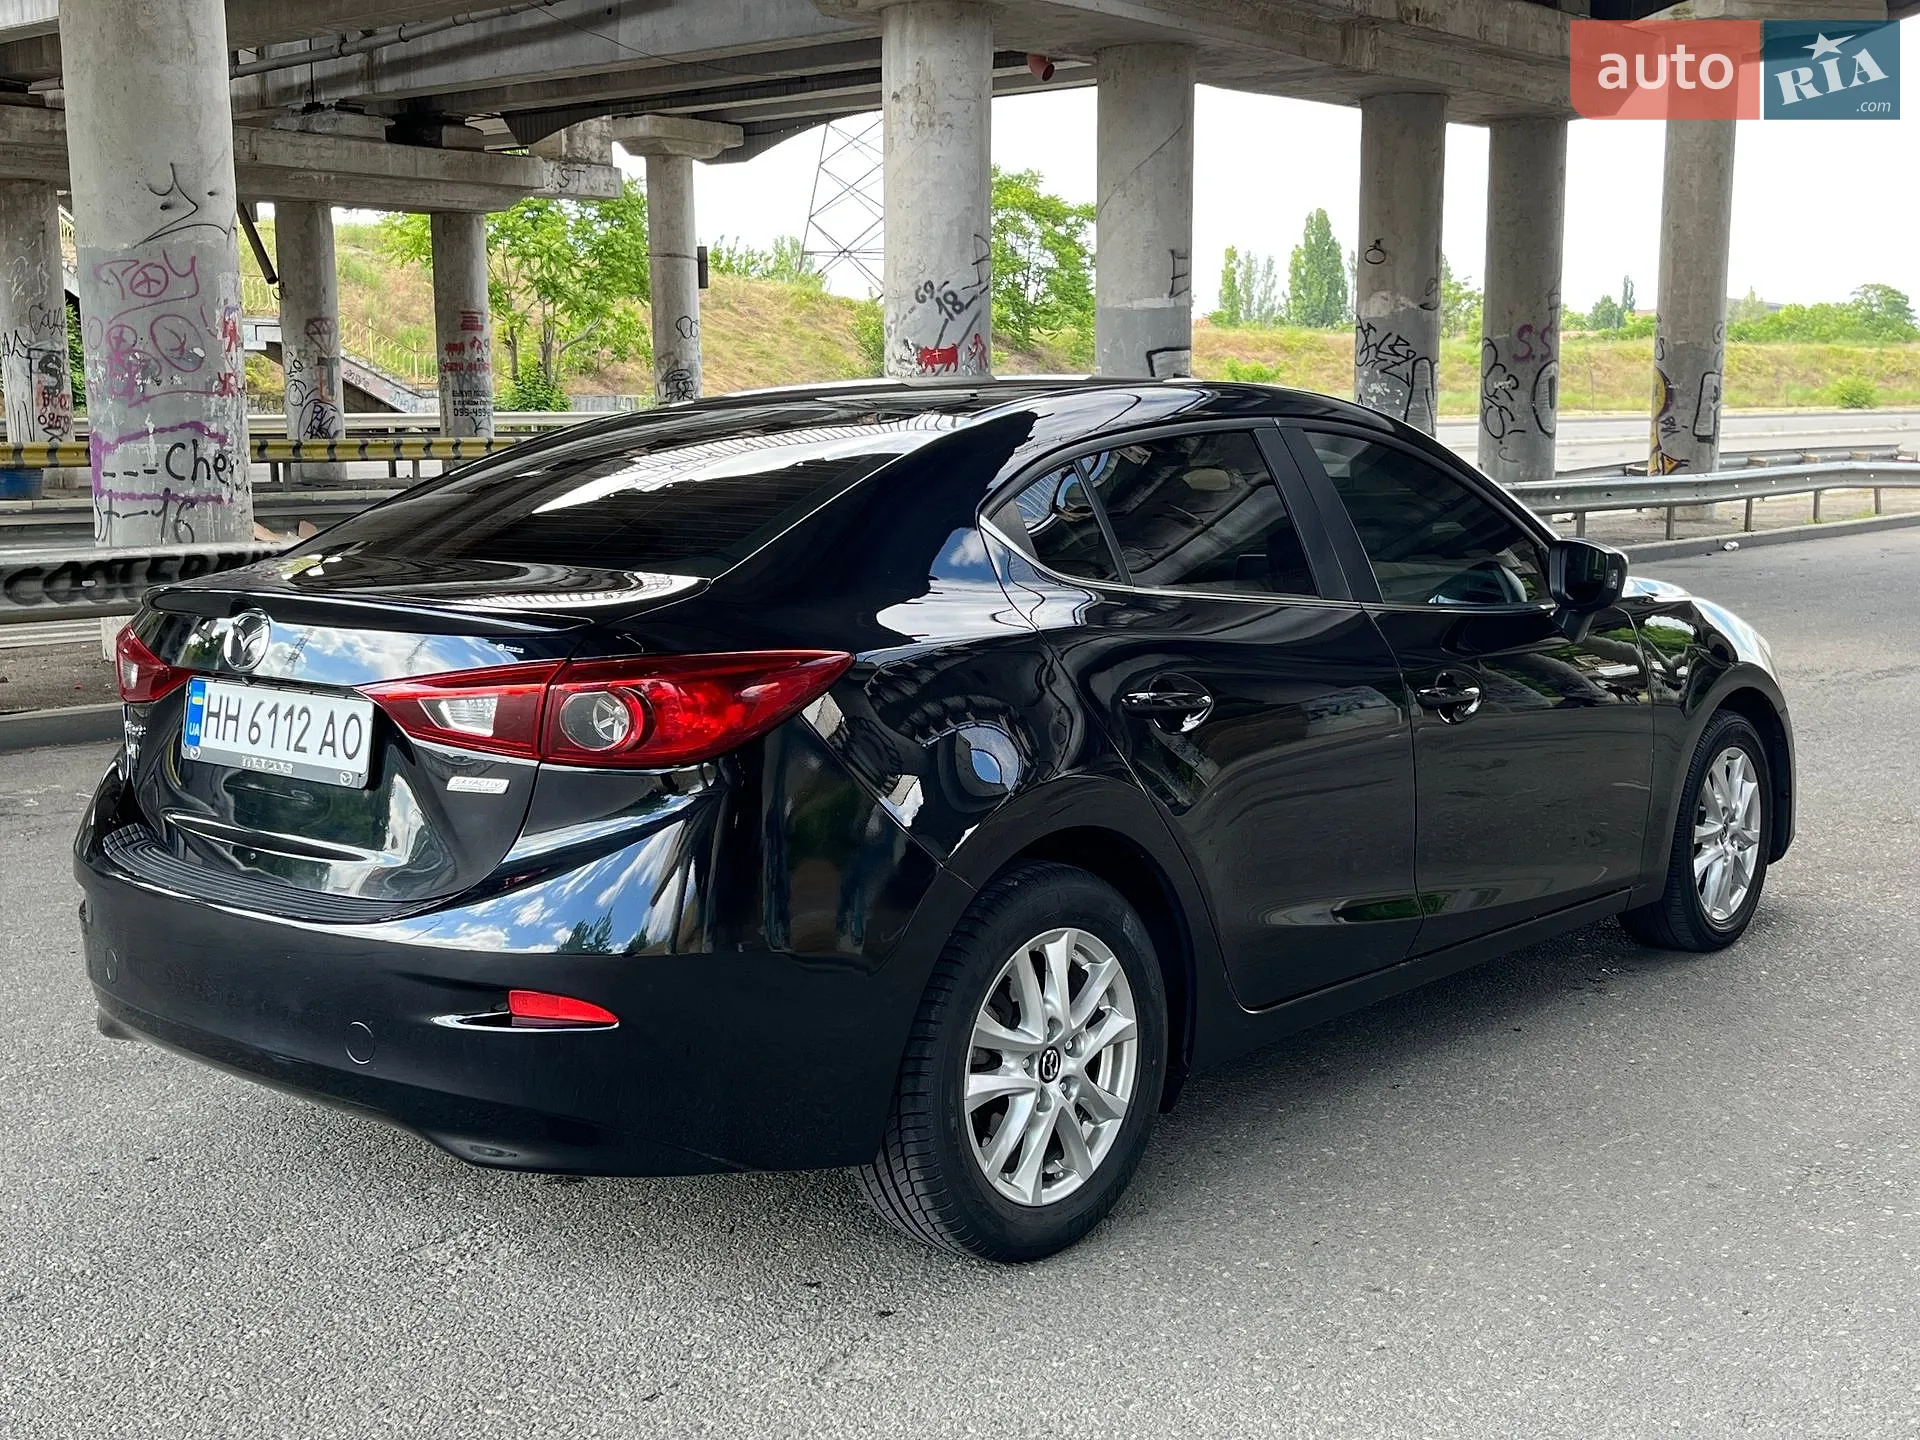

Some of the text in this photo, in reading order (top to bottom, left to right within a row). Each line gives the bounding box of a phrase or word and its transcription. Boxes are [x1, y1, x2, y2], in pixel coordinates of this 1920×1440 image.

[188, 722, 201, 737] UA
[204, 693, 243, 743] HH
[248, 700, 312, 754] 6112
[318, 710, 363, 760] AO
